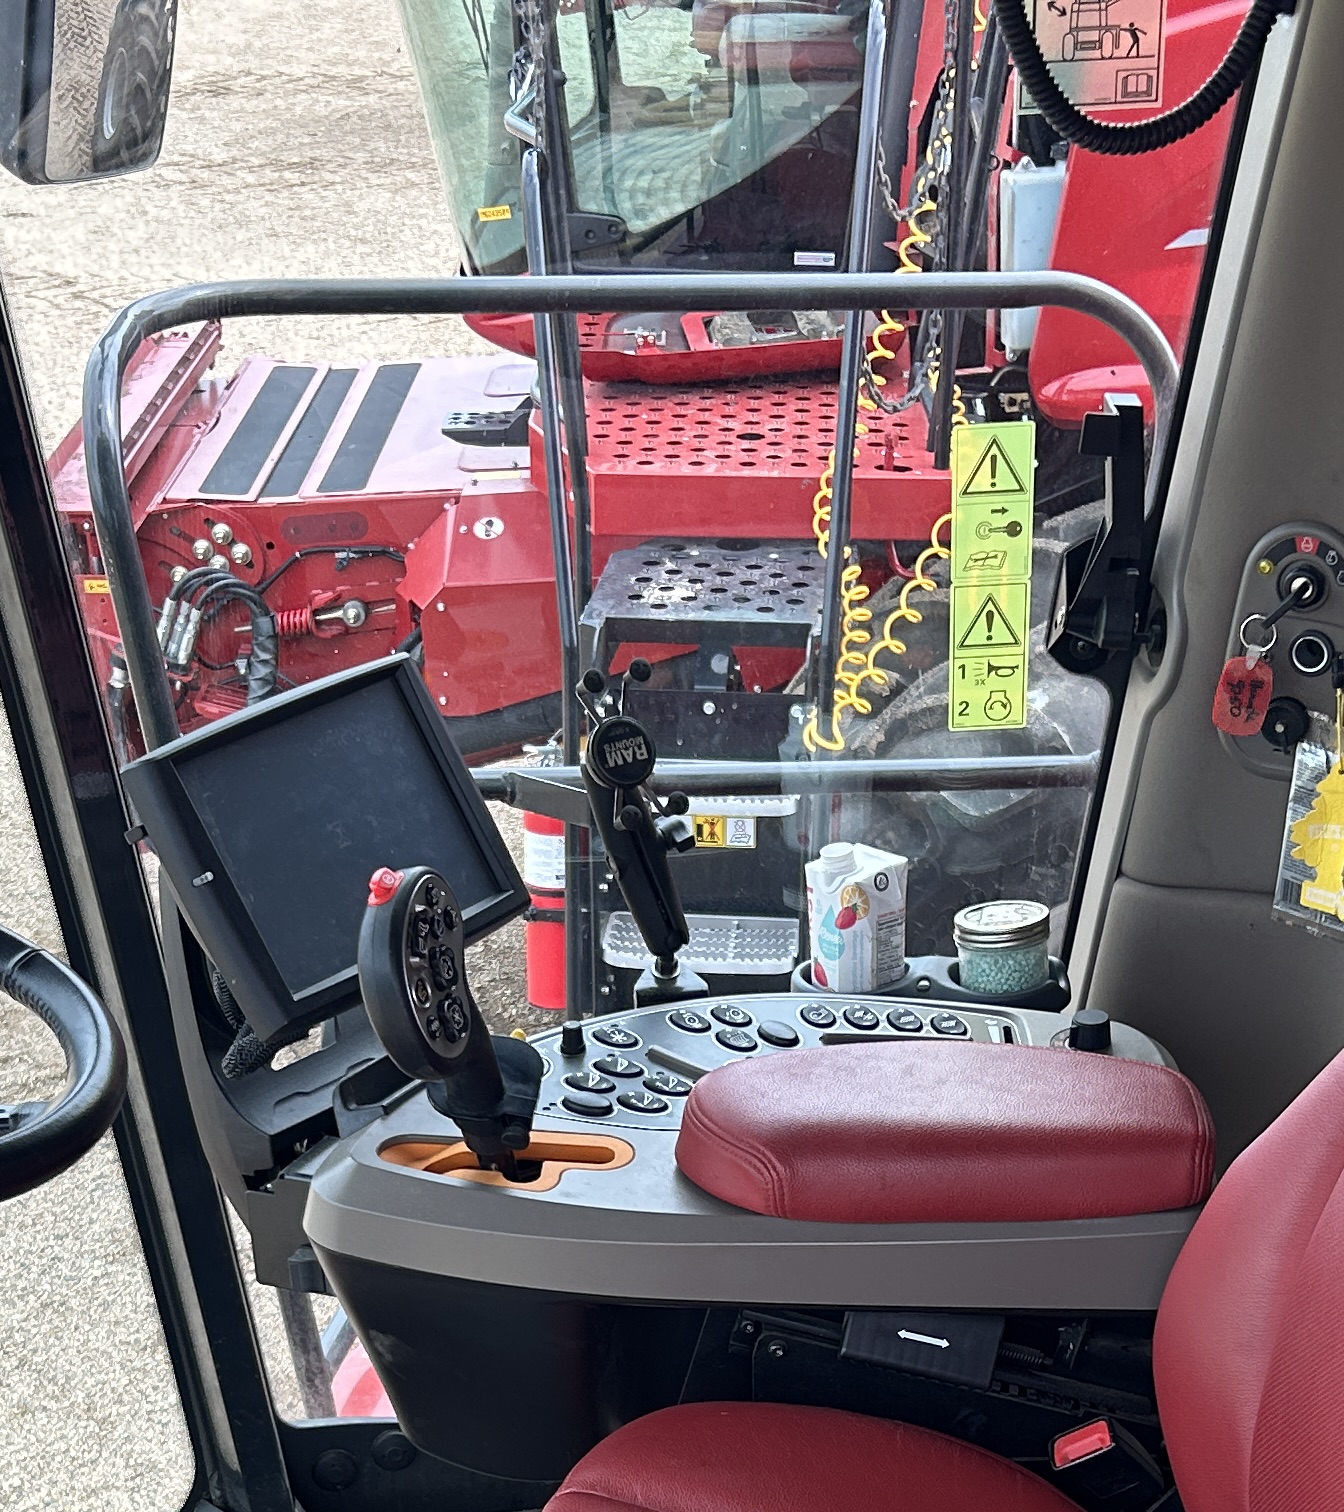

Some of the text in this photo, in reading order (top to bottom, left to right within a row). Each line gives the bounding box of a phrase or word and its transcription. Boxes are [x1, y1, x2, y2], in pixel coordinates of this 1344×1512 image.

[957, 663, 966, 680] 1
[957, 700, 970, 717] 2
[603, 736, 645, 752] MOUNTS
[605, 745, 649, 768] RAM
